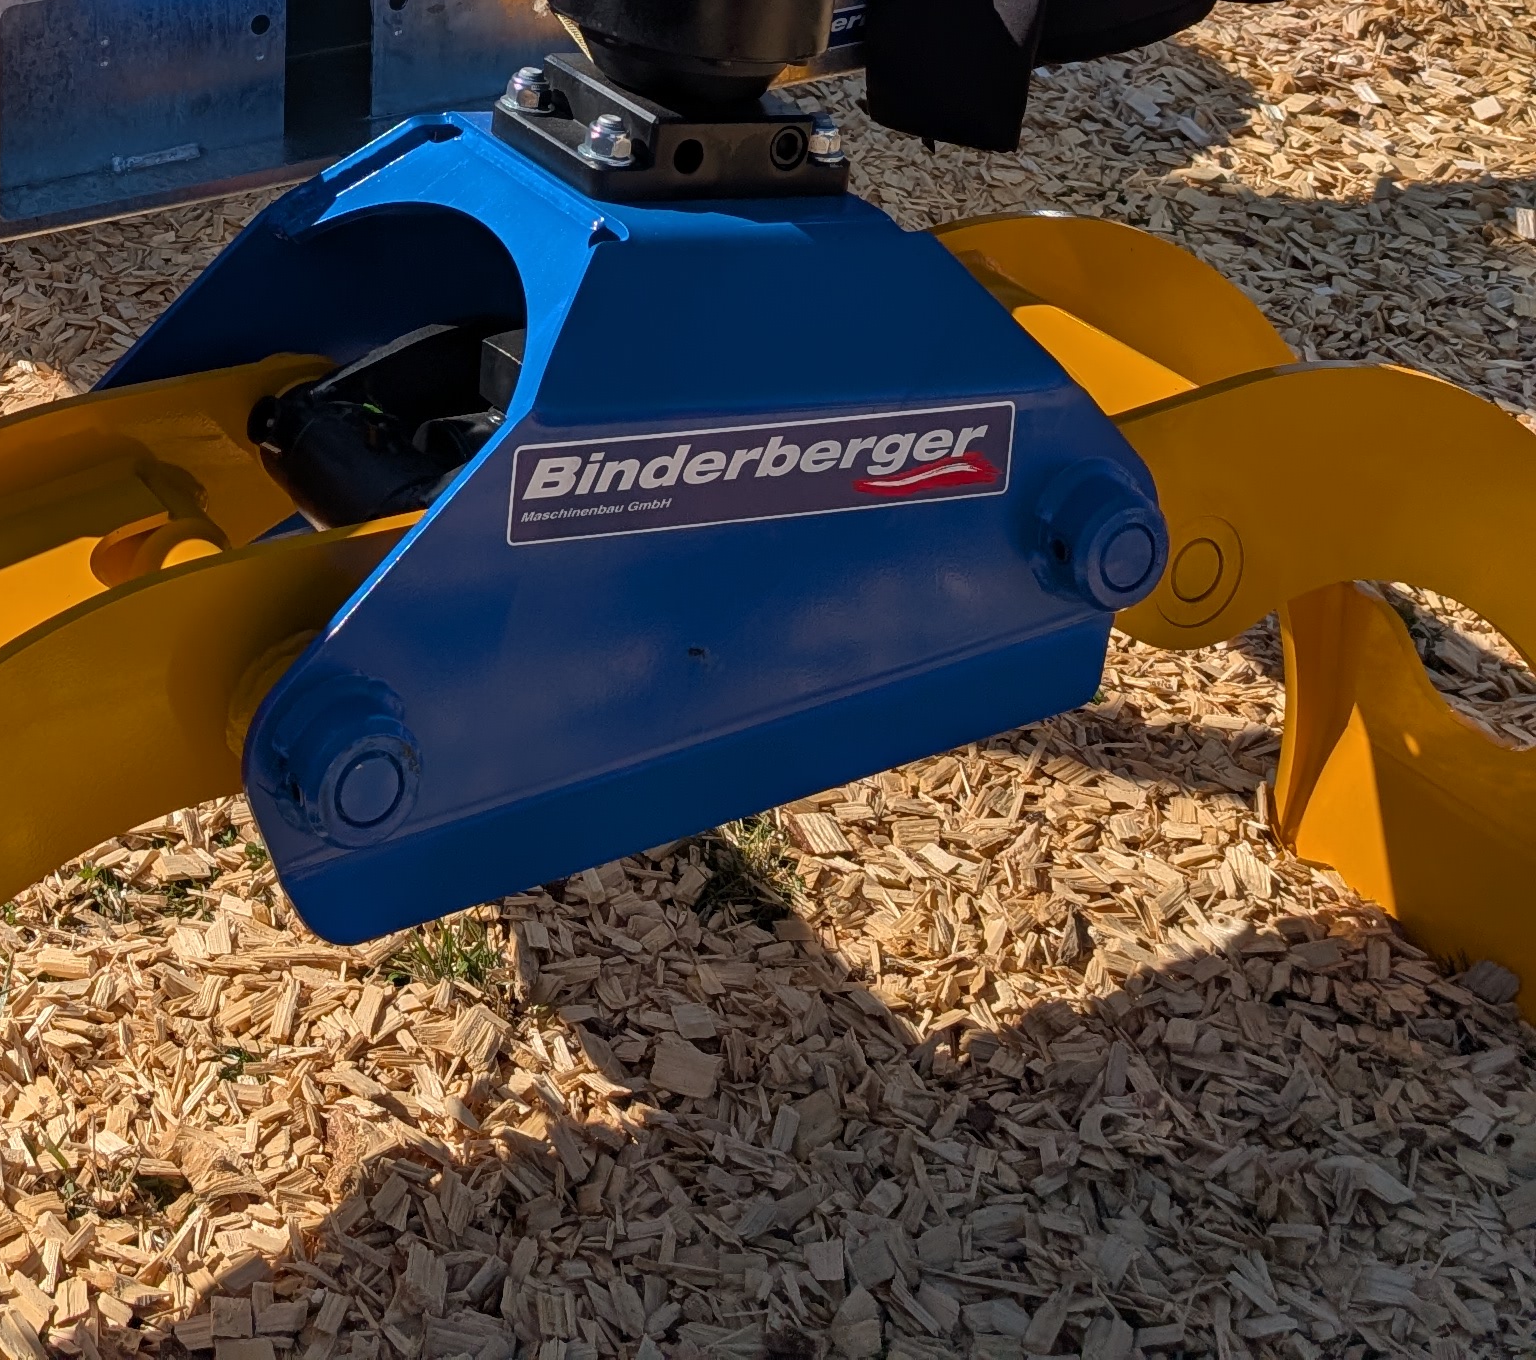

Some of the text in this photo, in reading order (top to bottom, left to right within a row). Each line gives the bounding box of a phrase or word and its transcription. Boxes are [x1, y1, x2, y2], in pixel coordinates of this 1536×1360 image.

[521, 422, 988, 501] Binderberger
[520, 497, 673, 524] Maschinenbau GmbH
